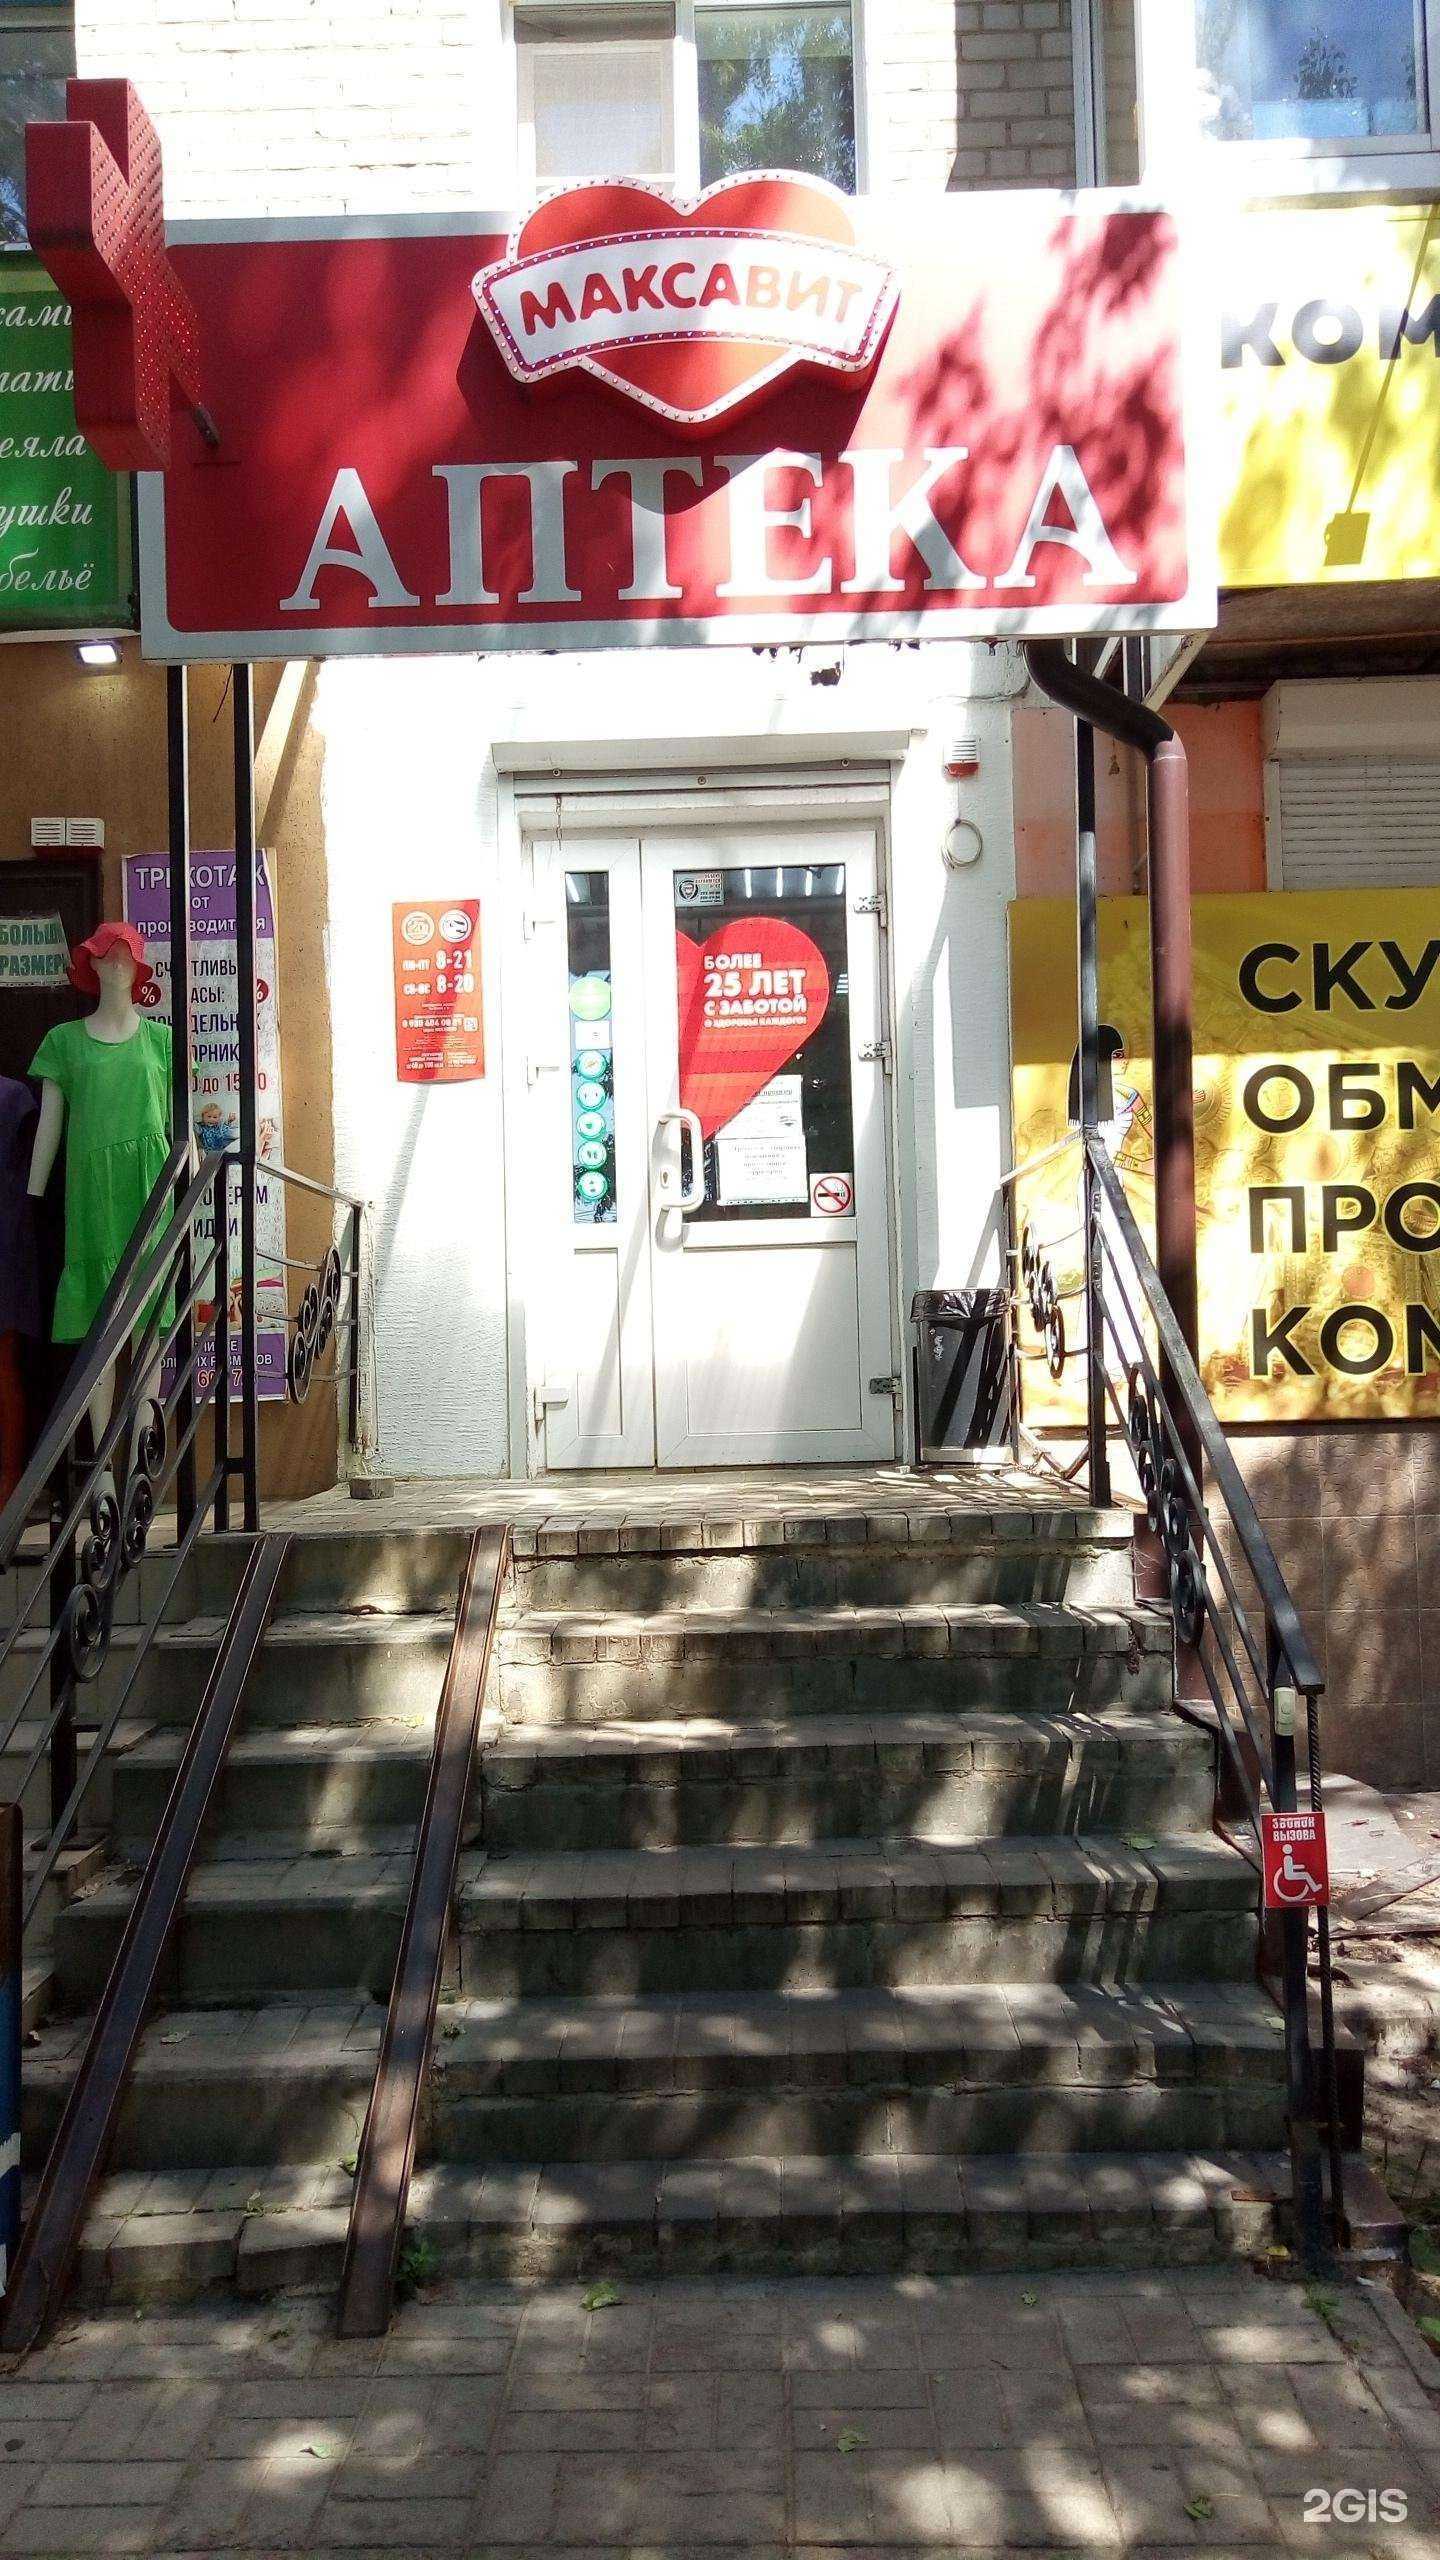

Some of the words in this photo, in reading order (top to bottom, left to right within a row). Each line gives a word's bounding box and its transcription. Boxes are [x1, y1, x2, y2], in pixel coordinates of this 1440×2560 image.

[519, 262, 863, 337] МАКСАВИТ
[1221, 294, 1440, 369] КОМ
[279, 444, 1138, 611] АПТЕКА
[191, 896, 210, 909] от
[0, 922, 61, 946] БОЛЬШ
[137, 918, 266, 938] проводитя
[0, 953, 67, 977] РАЗМЕР
[435, 949, 473, 971] 8-21
[703, 952, 763, 971] БОЛЕЕ
[435, 973, 476, 995] 8-20
[703, 970, 742, 998] 25
[748, 968, 807, 997] ЛЕТ
[1238, 939, 1440, 1014] СКУ
[190, 986, 226, 1004] АСЫ:
[703, 999, 716, 1017] С
[718, 993, 808, 1016] ЗАБОТОЙ
[1242, 1061, 1440, 1134] ОБМ
[1248, 1181, 1440, 1253] ПРО
[1272, 1816, 1316, 1829] ЗВОНОК
[1272, 1829, 1317, 1842] ВЫЗОВА
